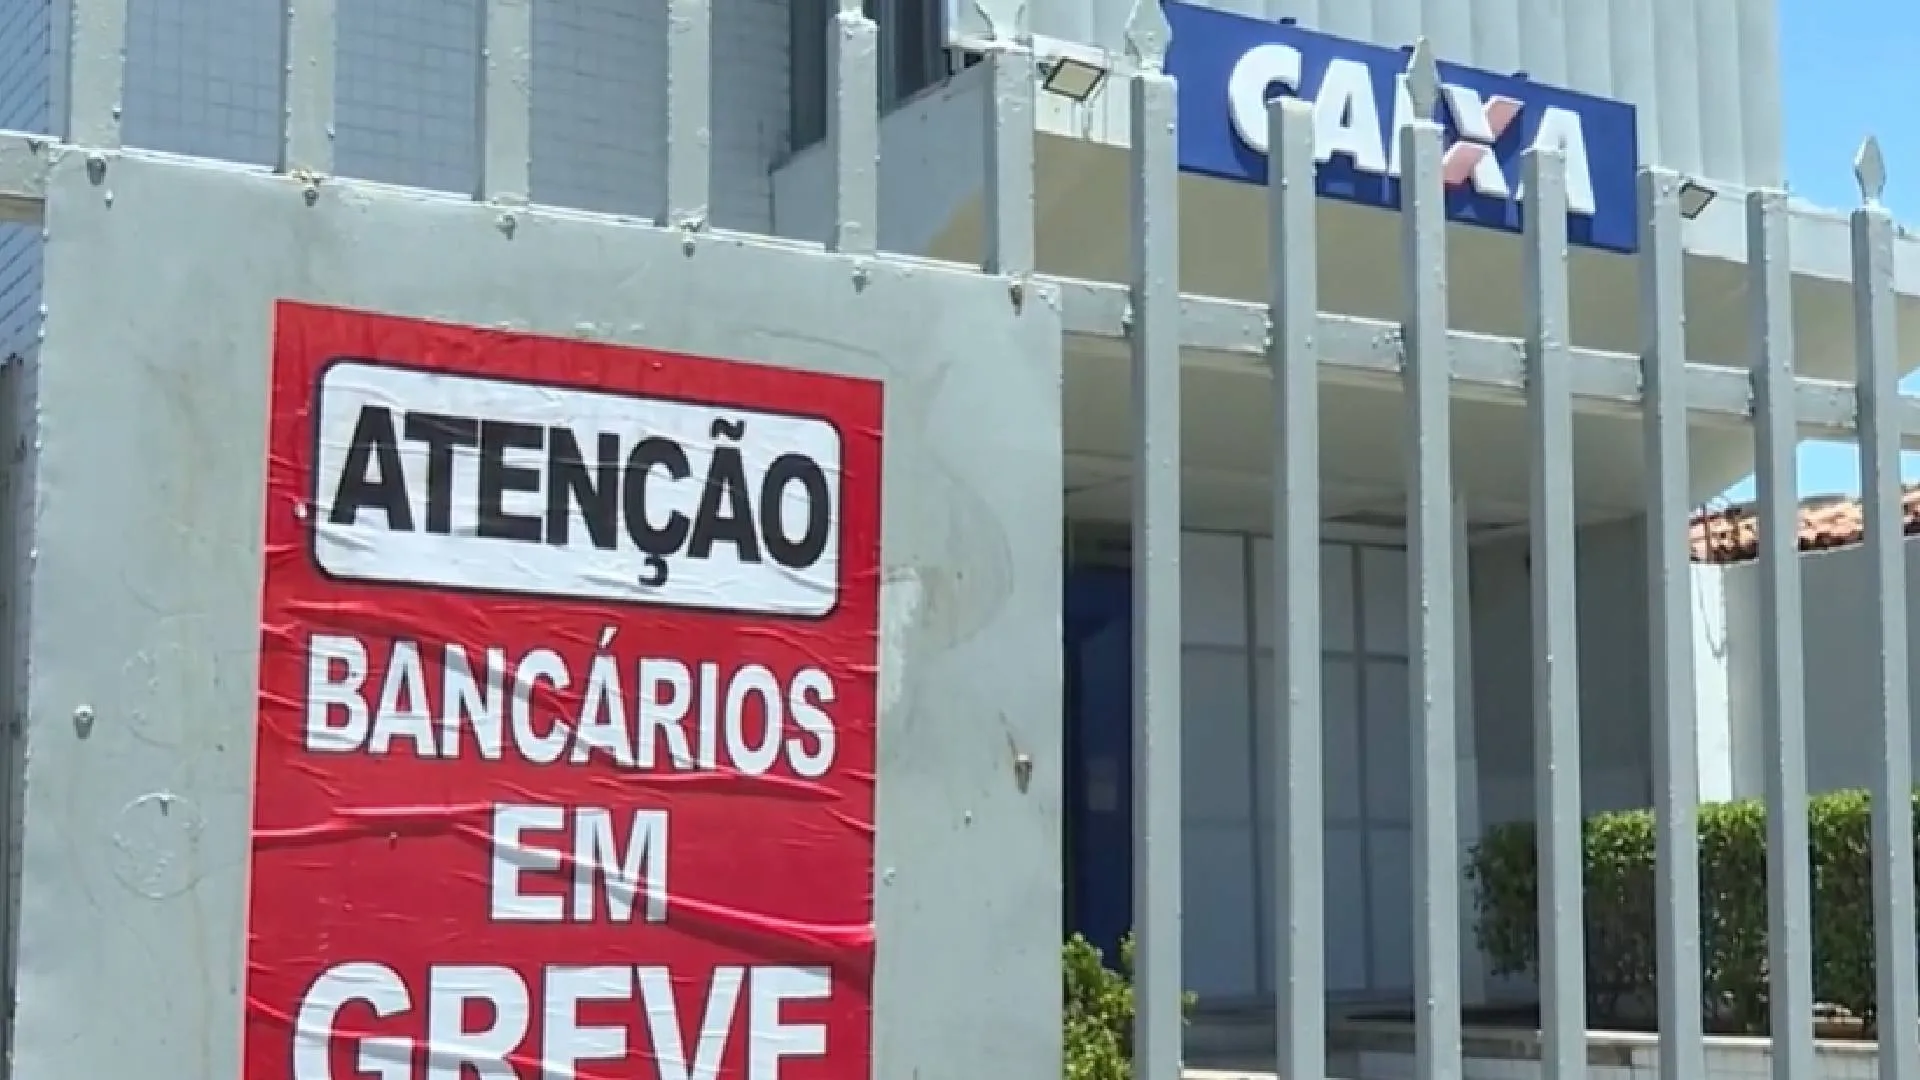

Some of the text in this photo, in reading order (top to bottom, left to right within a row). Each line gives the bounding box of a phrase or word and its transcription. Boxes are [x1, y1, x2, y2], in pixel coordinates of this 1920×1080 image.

[329, 405, 831, 587] ATENÇÃO
[306, 627, 836, 777] BANCÁRIOS
[490, 803, 669, 922] EM
[293, 961, 833, 1080] GREVE
